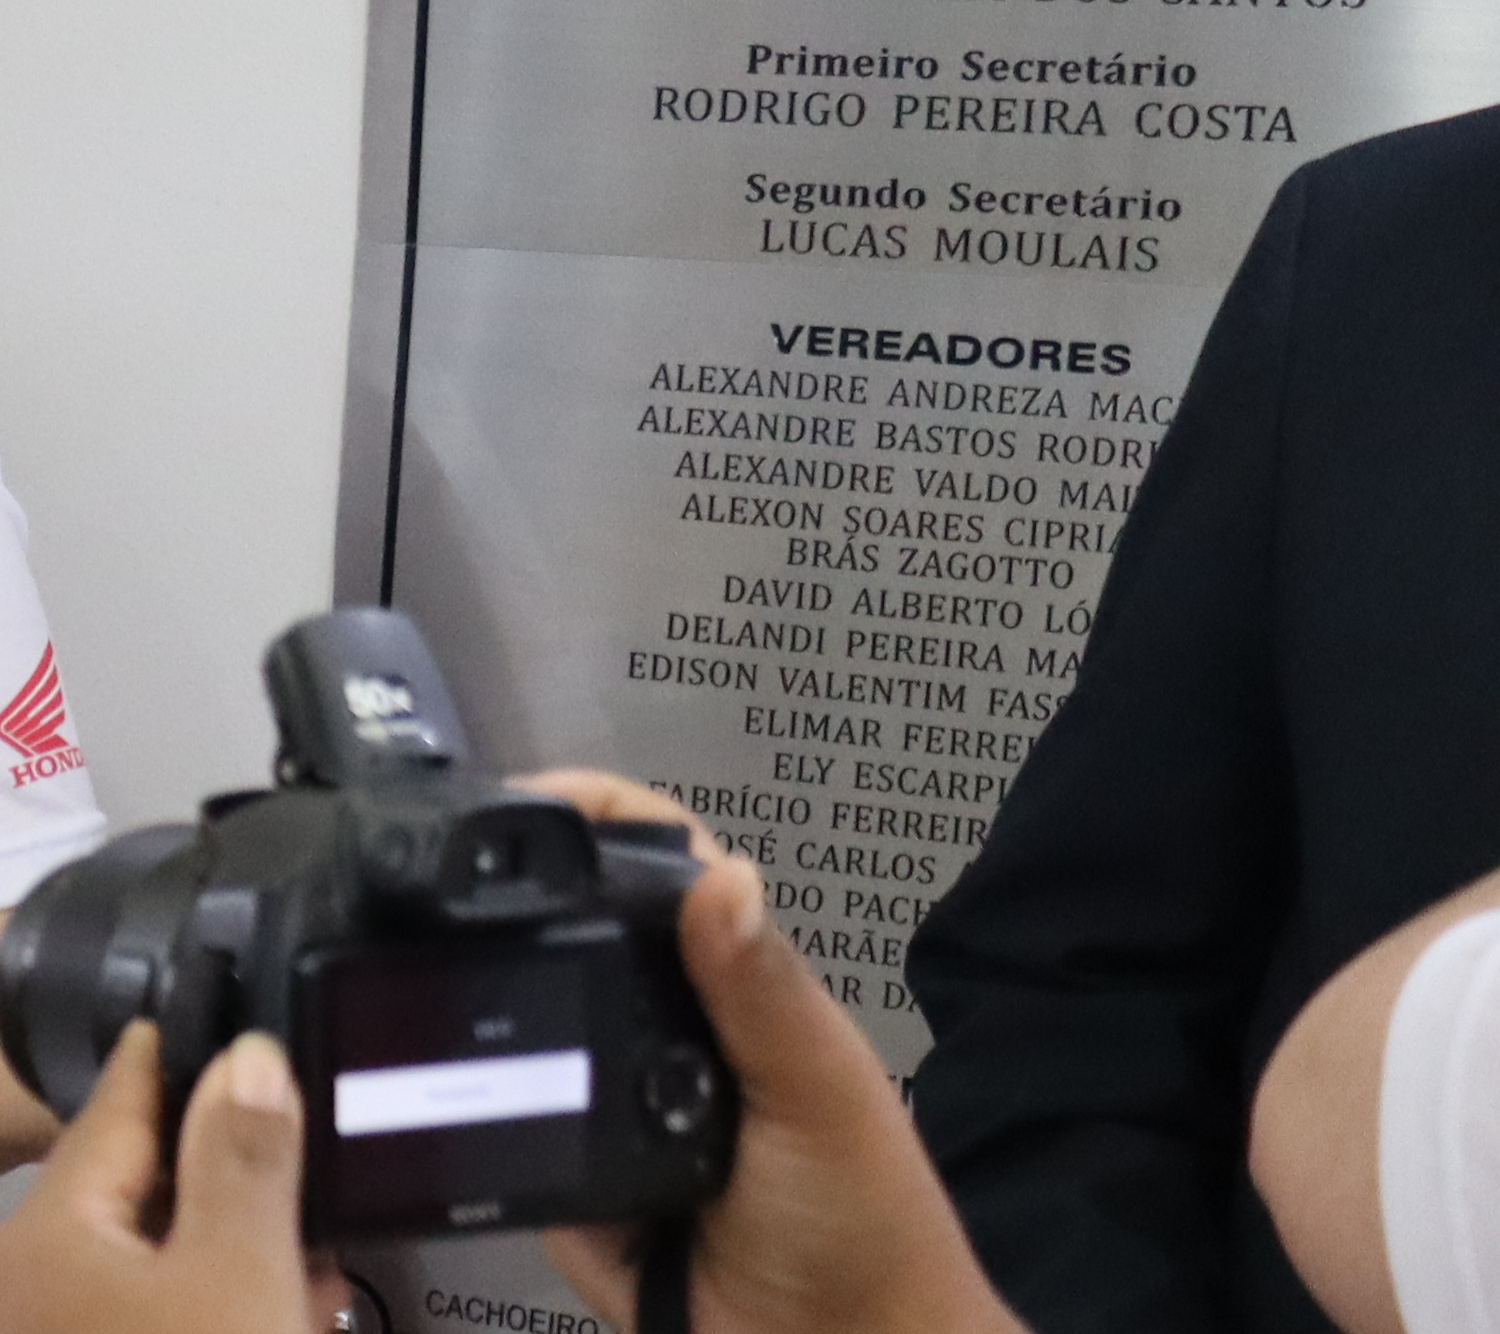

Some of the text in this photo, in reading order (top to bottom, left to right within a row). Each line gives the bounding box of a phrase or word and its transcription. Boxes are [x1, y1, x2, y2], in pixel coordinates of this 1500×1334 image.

[747, 44, 1197, 87] Primeiro Secretário
[653, 86, 1298, 143] RODRIGO PEREIRA COSTA
[745, 173, 1182, 222] Segundo Secretário
[760, 218, 1160, 272] LUCAS MOULAIS
[770, 323, 1131, 376] VEREADORES
[649, 363, 869, 405] ALEXANDRE
[886, 378, 1068, 419] ANDREZA
[637, 405, 857, 449] ALEXANDRE
[874, 422, 1017, 460] BASTOS
[673, 450, 1038, 506] ALEXANDRE VALDO
[680, 493, 825, 531] ALEXON
[843, 506, 985, 544] SOARES
[786, 536, 1075, 590] BRÁS ZAGOTTO
[723, 574, 833, 612] DAVID
[850, 588, 1024, 630] ALBERTO
[666, 612, 826, 655] DELANDI
[845, 630, 1006, 673] PEREIRA
[628, 651, 759, 692] EDISON
[777, 666, 968, 714] VALENTIM
[744, 706, 882, 748] ELIMAR
[772, 753, 835, 785] ELY
[795, 841, 937, 885] CARLOS
